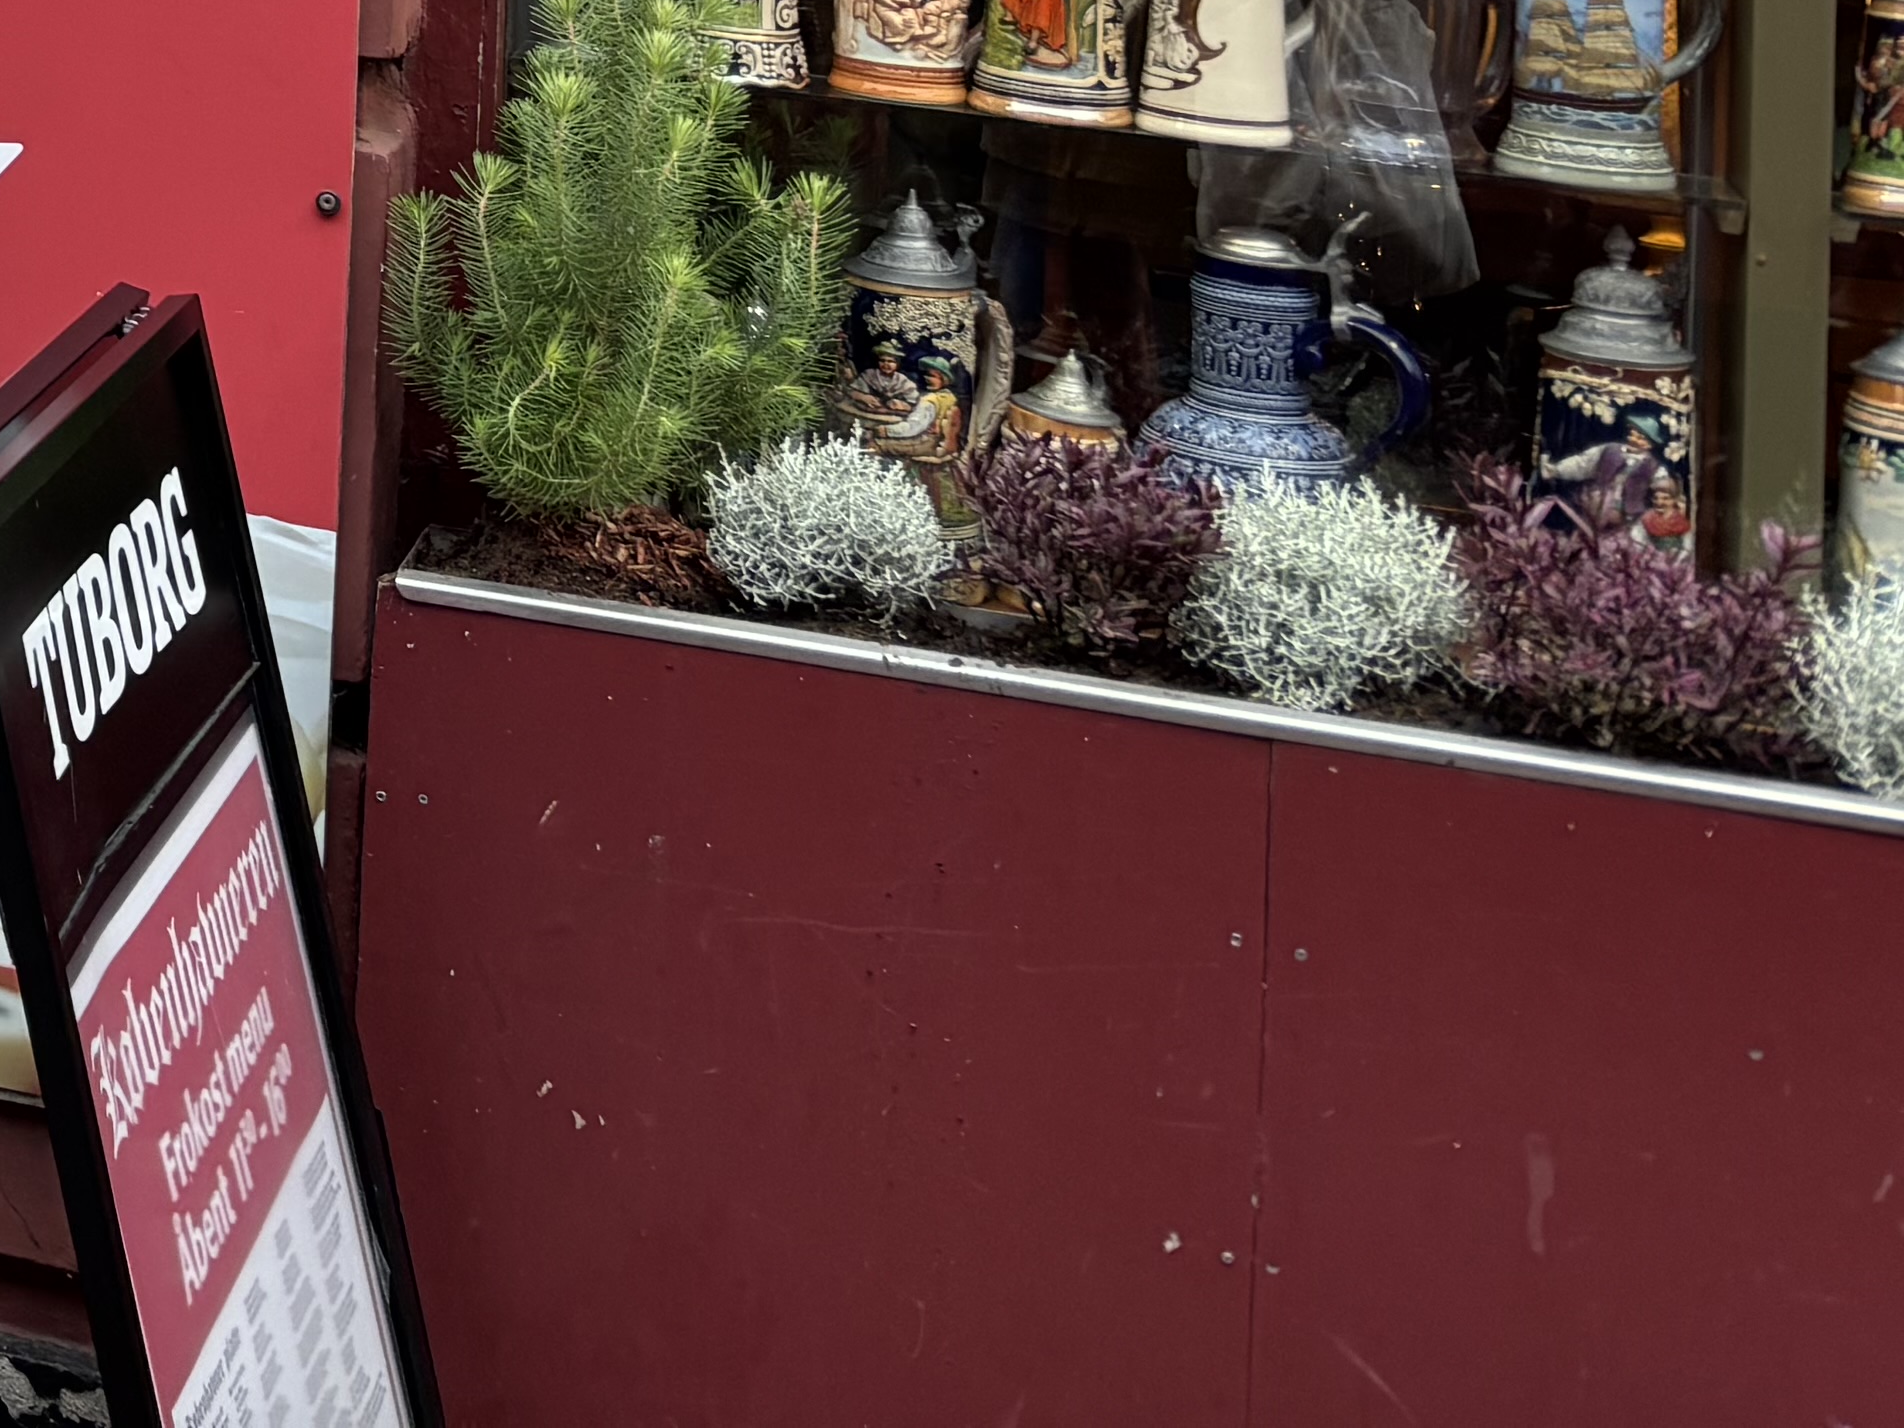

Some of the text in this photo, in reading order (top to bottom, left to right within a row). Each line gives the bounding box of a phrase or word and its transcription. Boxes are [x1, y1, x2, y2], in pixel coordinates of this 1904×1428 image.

[22, 466, 206, 780] TUBORG
[158, 986, 274, 1202] Frokost menu
[173, 1165, 237, 1306] Åbent
